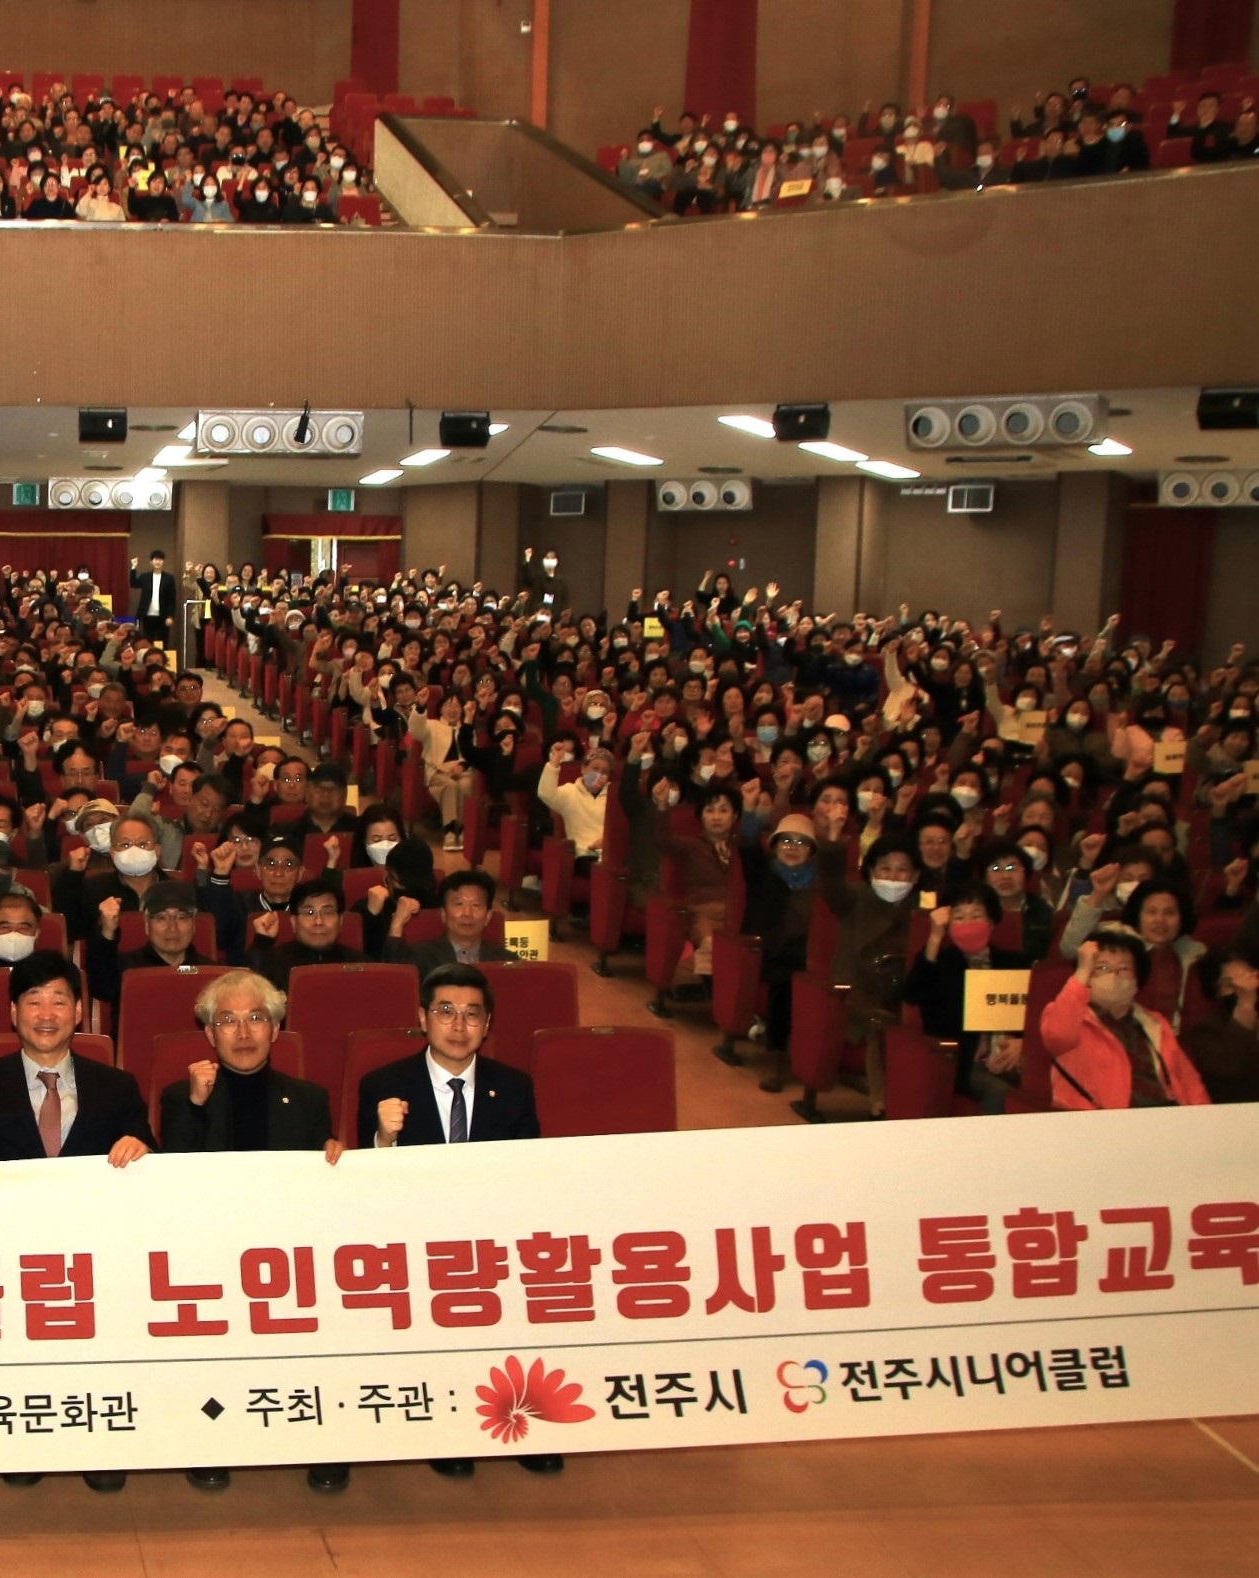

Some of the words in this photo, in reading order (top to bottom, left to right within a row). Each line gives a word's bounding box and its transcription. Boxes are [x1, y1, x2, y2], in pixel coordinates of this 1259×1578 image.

[148, 1221, 871, 1337] 노인역량활용사업
[917, 1201, 1259, 1304] 통합교육
[604, 1368, 748, 1420] 전주시
[839, 1345, 1130, 1403] 전주시니어클럽
[245, 1385, 323, 1428] 주최
[357, 1381, 435, 1424] 주관
